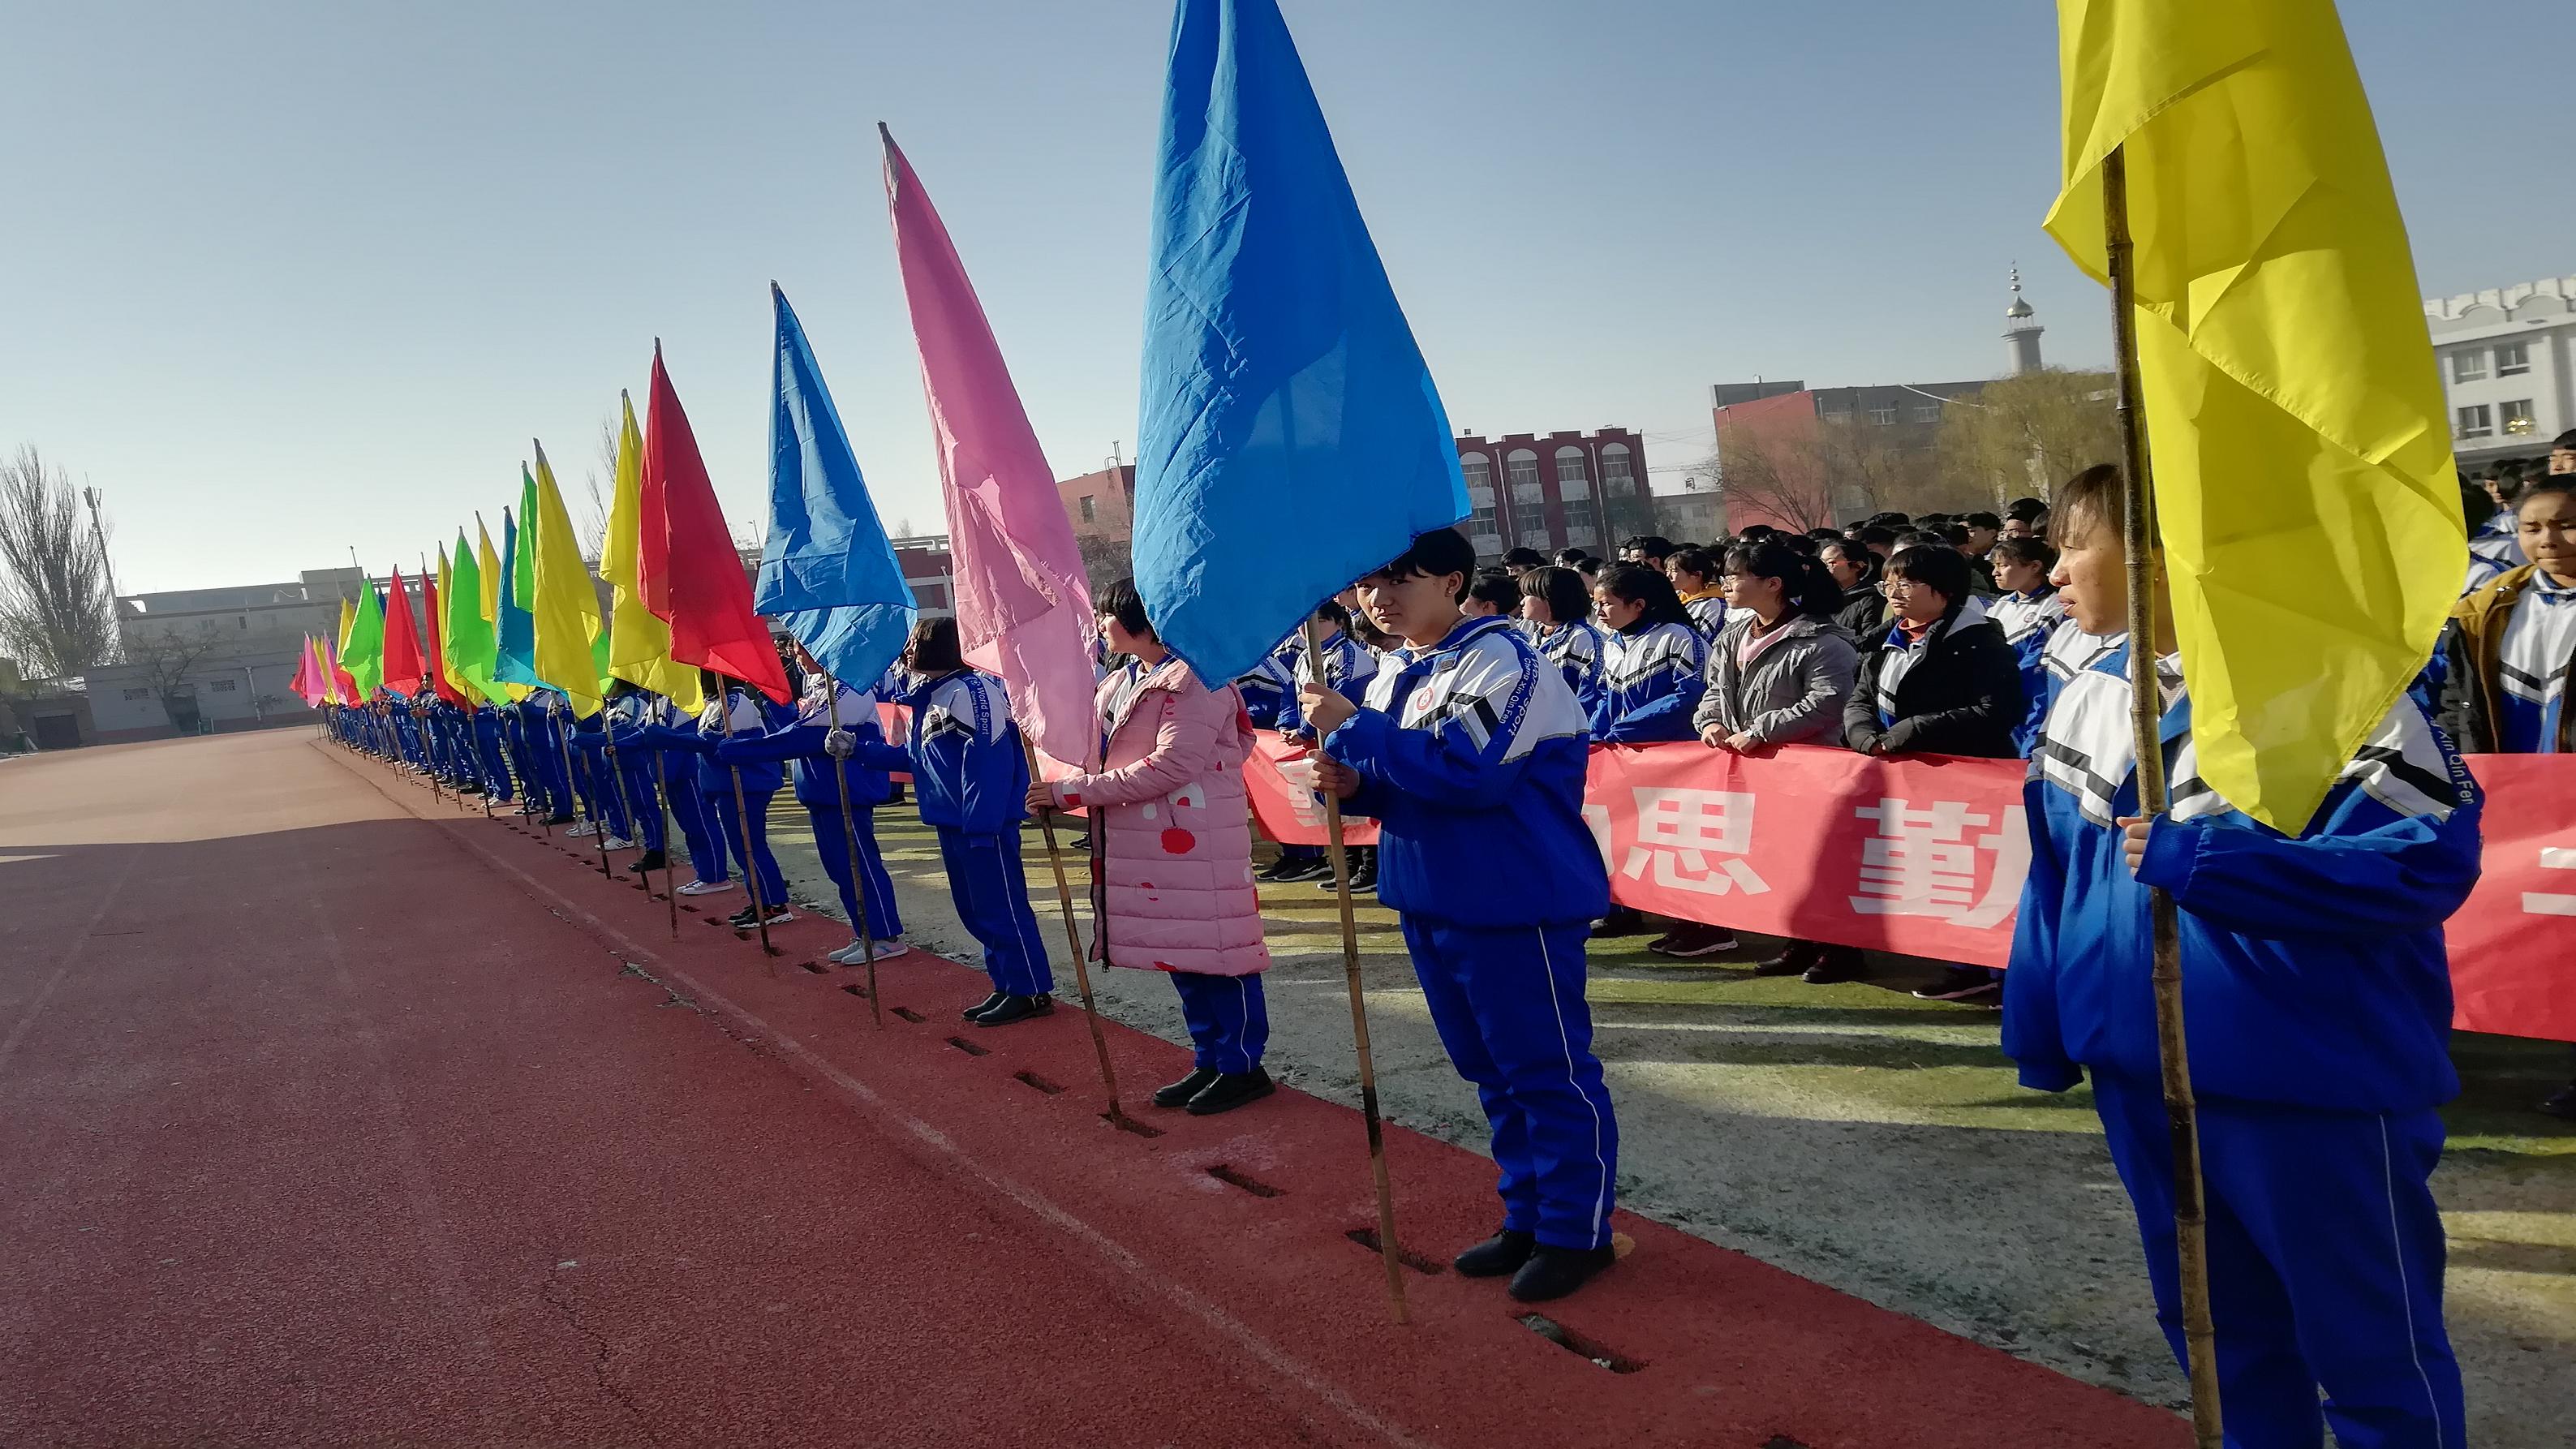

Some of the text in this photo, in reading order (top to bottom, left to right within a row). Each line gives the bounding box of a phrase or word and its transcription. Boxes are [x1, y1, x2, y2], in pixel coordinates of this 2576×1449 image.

[977, 687, 989, 710] World
[1515, 682, 1527, 694] Xin
[1507, 695, 1520, 708] Qin
[980, 712, 990, 735] Sport
[1499, 709, 1513, 724] Fen
[1507, 698, 1530, 737] Sport
[2449, 754, 2466, 777] Qin
[2456, 780, 2475, 805] Fen
